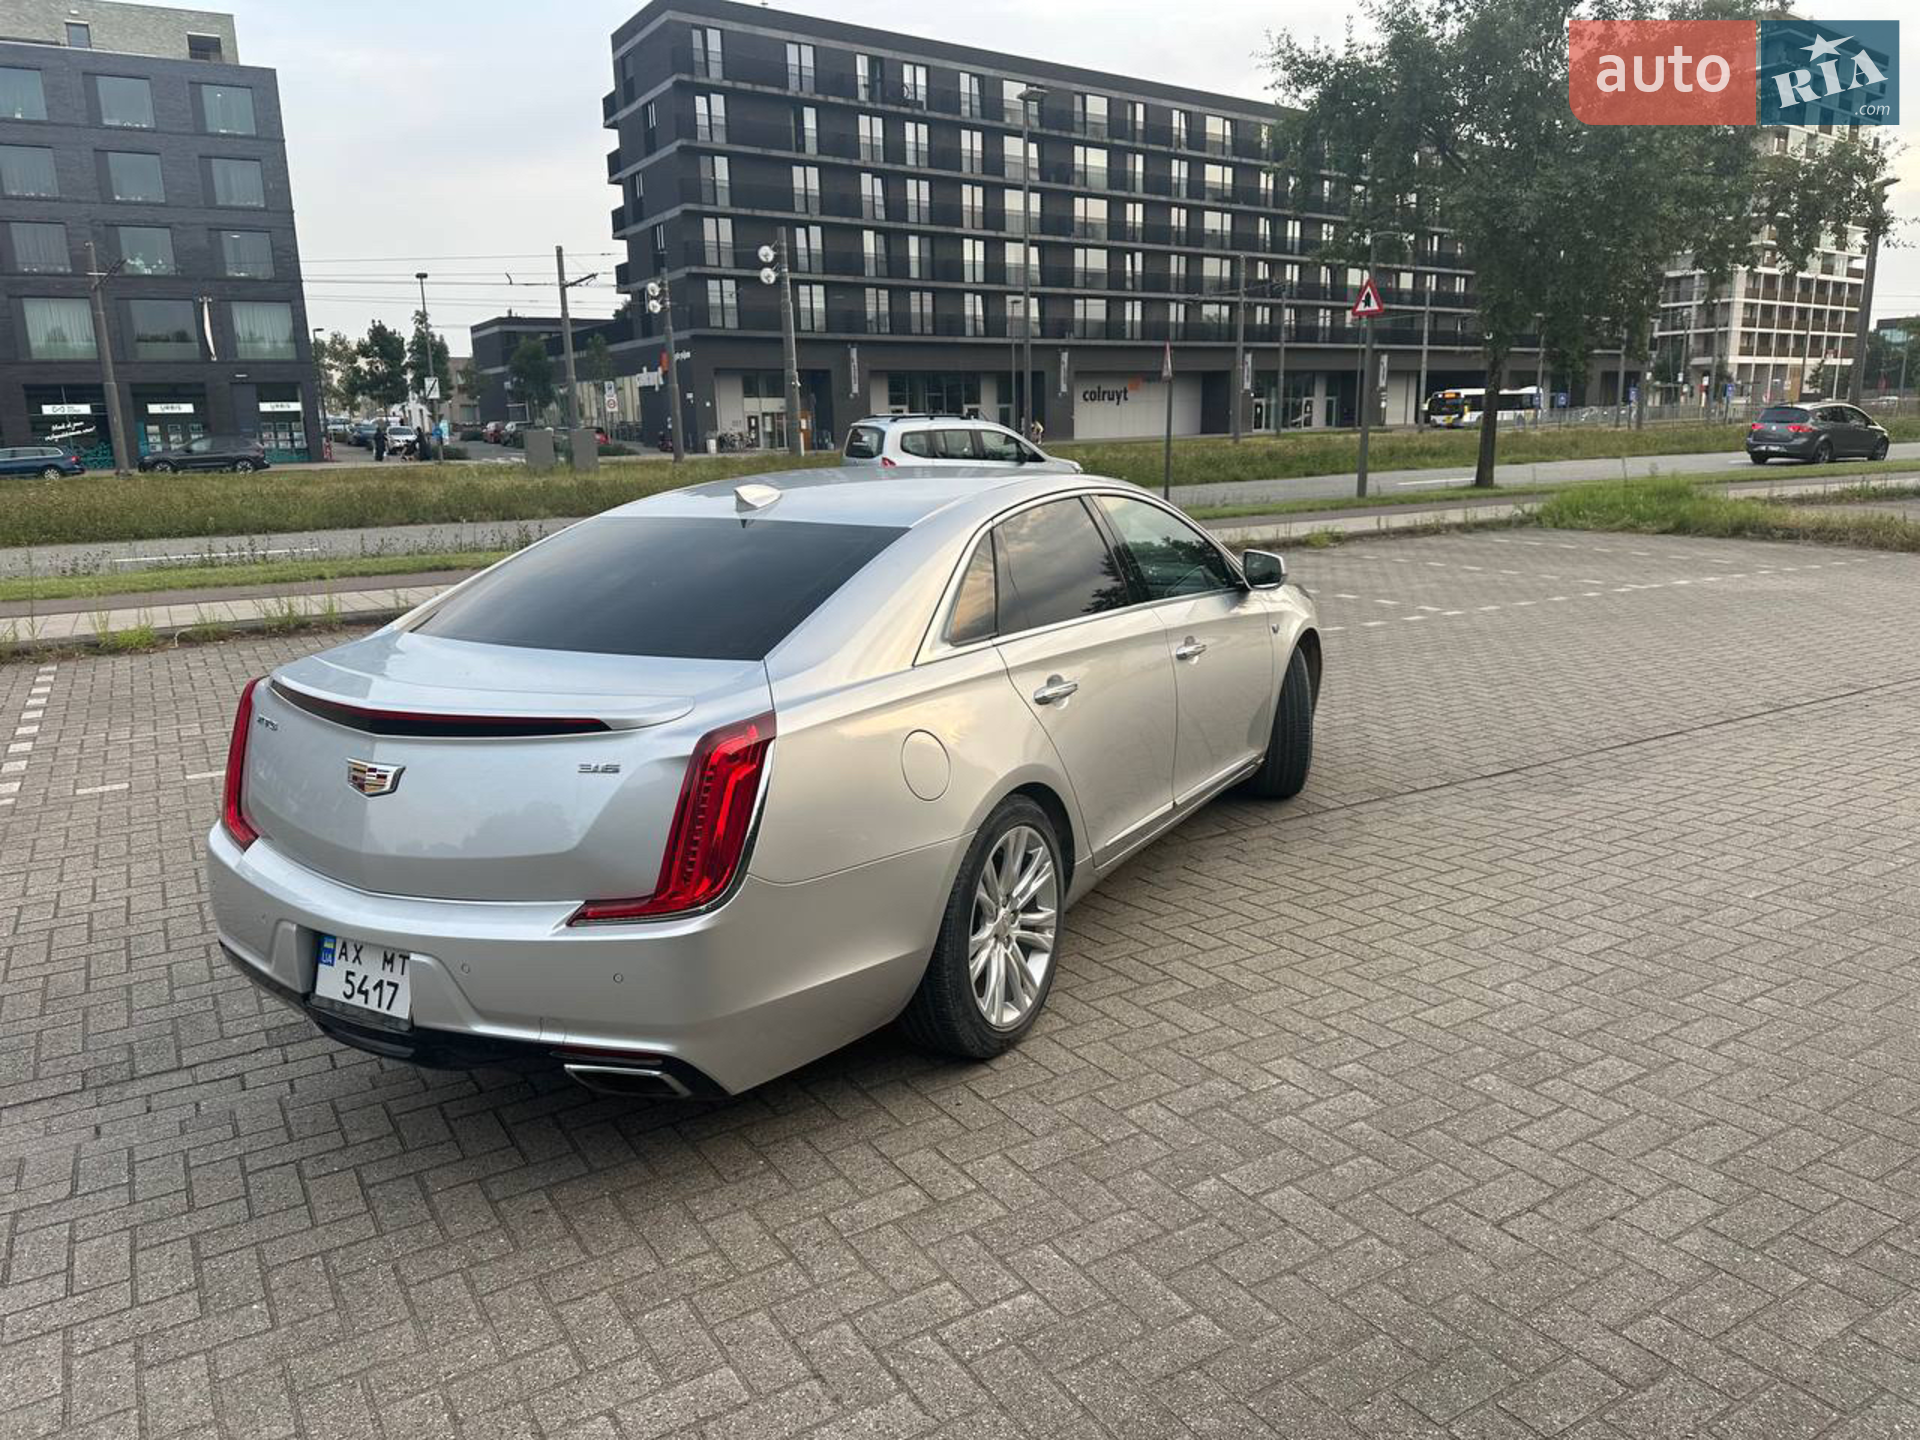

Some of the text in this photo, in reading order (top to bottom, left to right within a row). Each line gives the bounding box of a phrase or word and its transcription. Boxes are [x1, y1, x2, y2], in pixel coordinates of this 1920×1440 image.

[1082, 385, 1129, 406] colruyt
[338, 940, 410, 975] AX MT
[342, 970, 400, 1011] 5417
